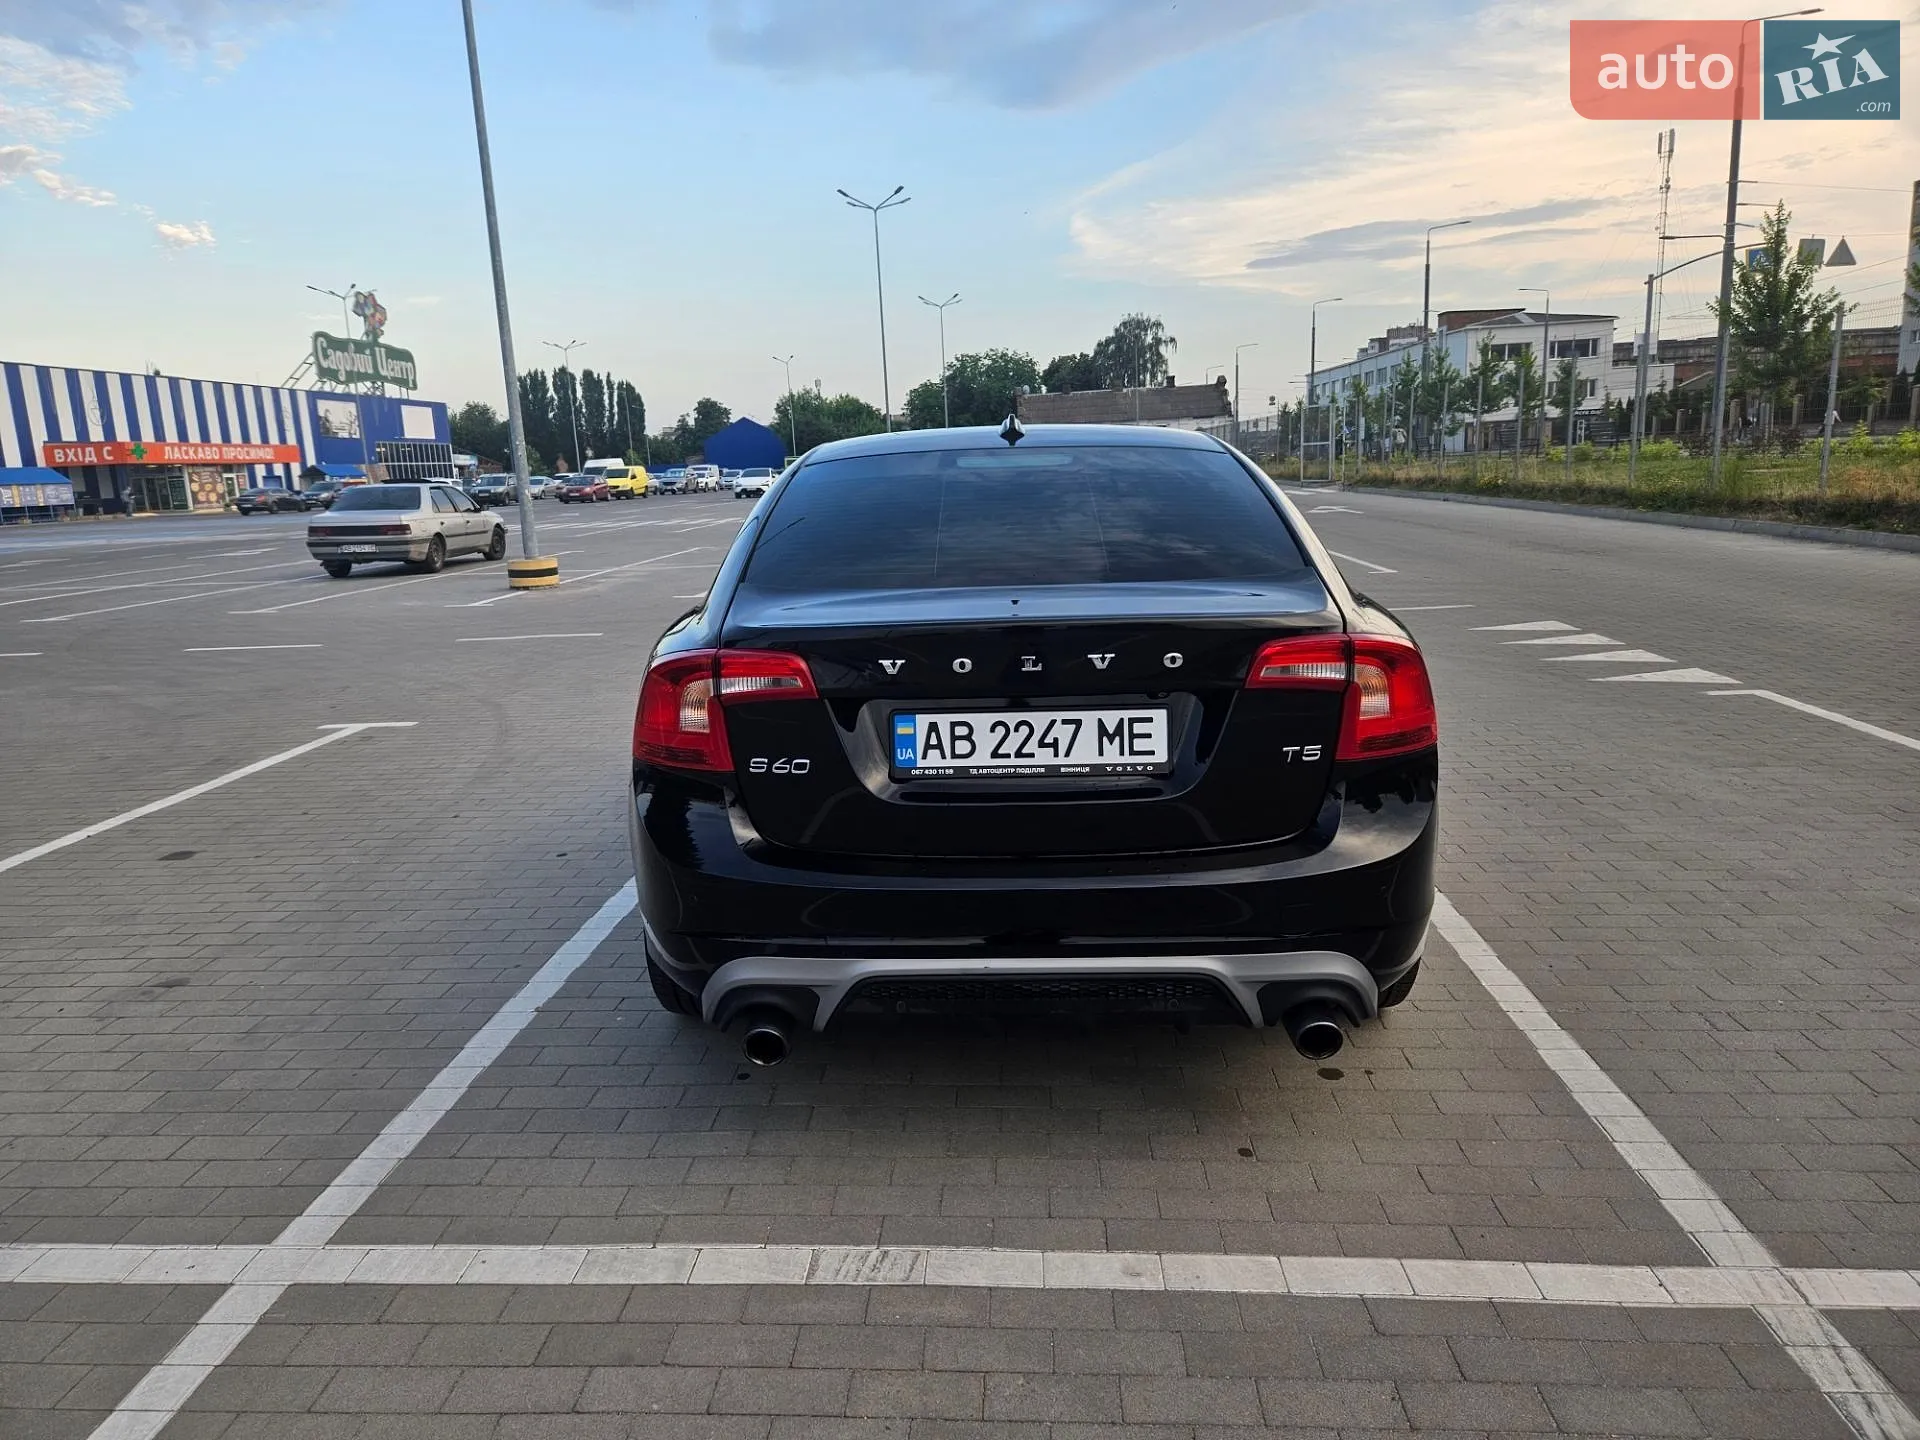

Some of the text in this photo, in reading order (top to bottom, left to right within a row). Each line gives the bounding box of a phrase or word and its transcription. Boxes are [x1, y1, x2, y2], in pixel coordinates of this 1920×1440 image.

[316, 336, 416, 388] Садовий Центр
[53, 446, 98, 463] ВХІД
[164, 446, 276, 460] ЛАСКАВО ПРОСИМО!
[878, 652, 1184, 675] VOLVO
[921, 716, 1156, 760] AB 2247 ME
[897, 748, 915, 760] UA
[1282, 744, 1322, 763] T5
[749, 757, 810, 774] S60
